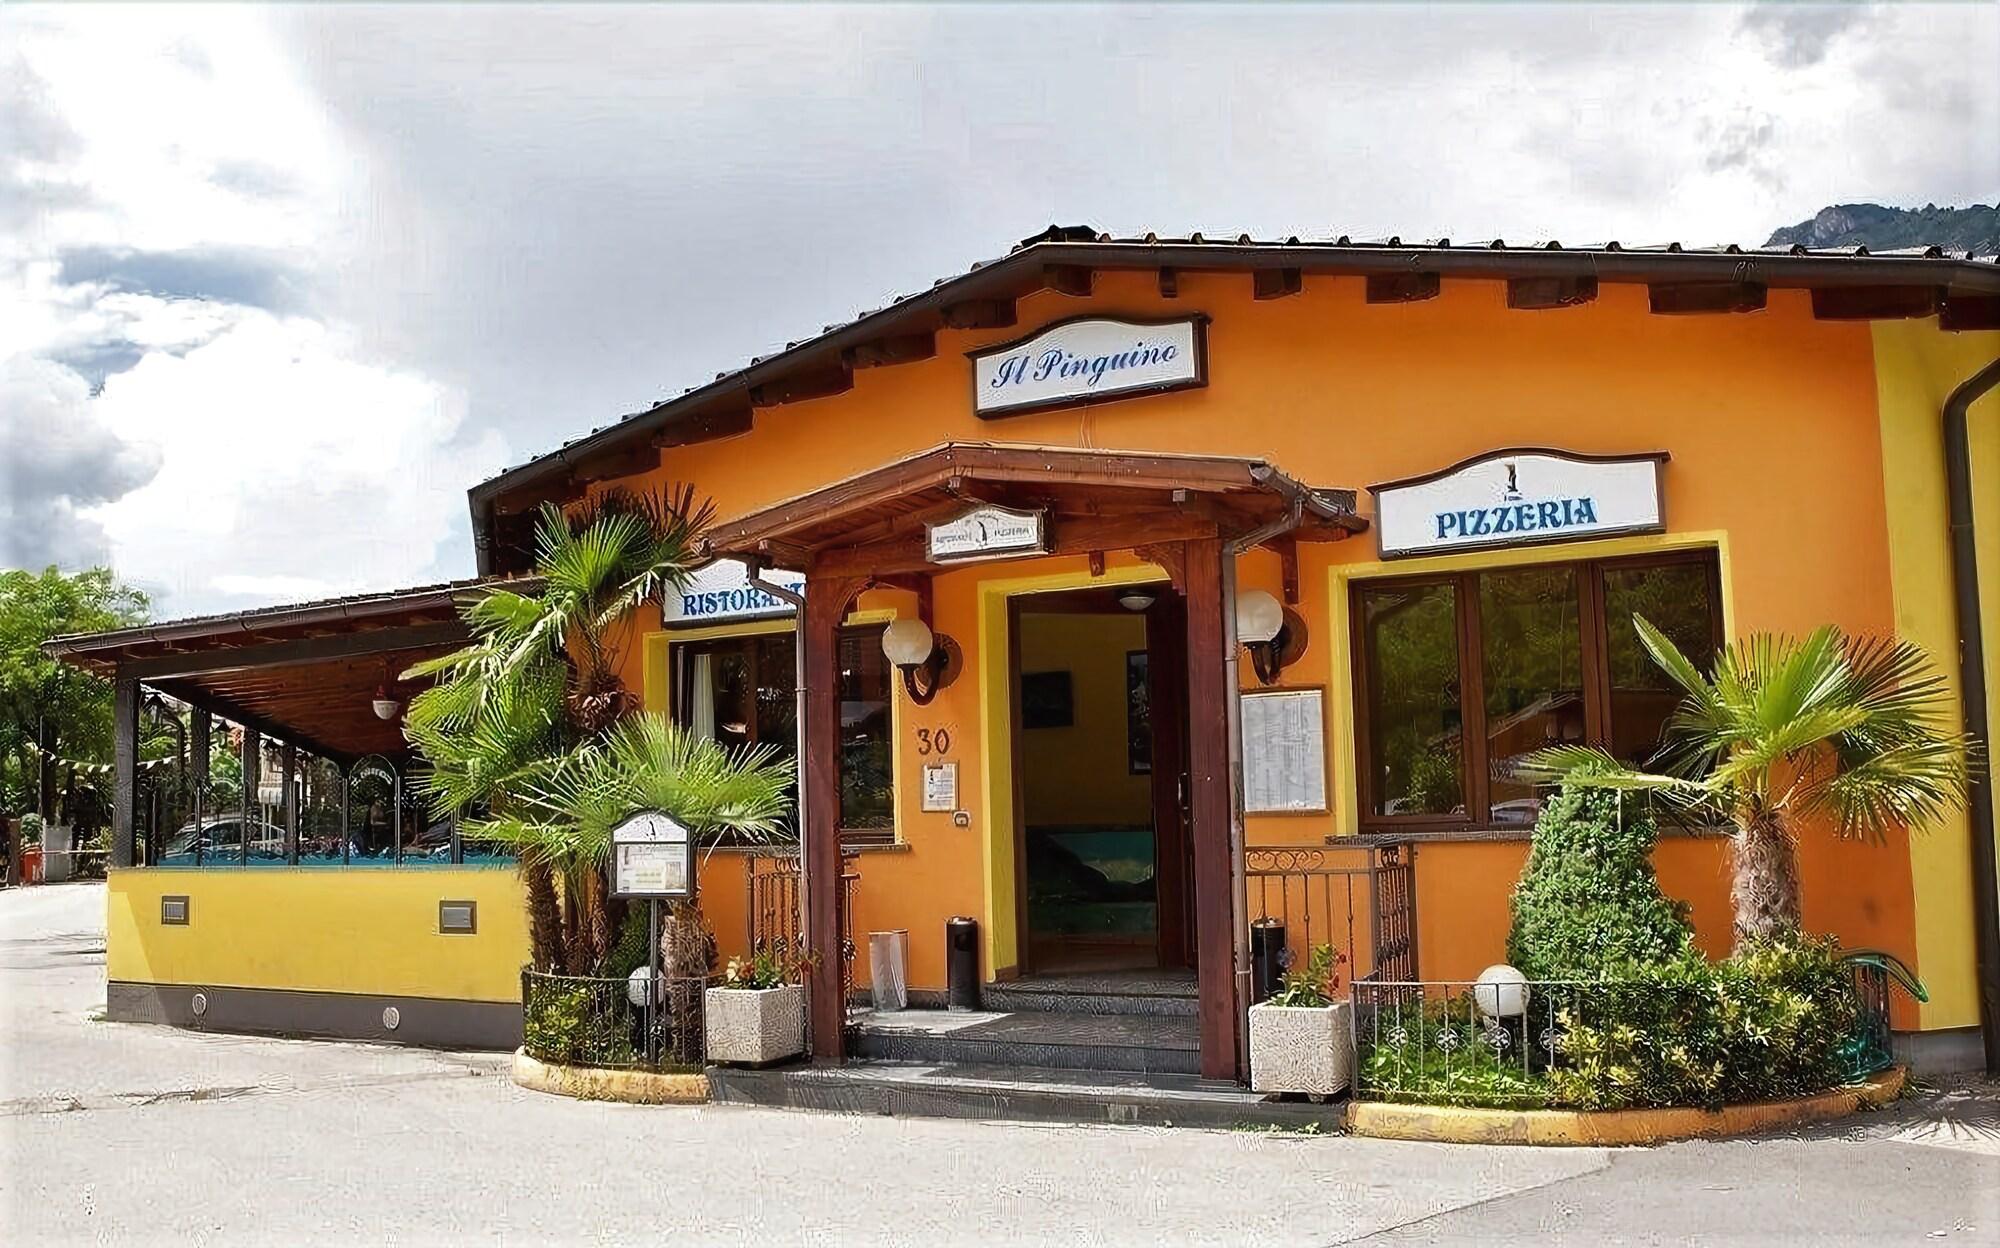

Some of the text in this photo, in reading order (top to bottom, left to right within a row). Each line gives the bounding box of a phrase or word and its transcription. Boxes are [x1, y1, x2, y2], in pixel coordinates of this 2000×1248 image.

[992, 341, 1178, 388] Il Pinguino
[1435, 497, 1597, 539] PIZZERIA
[918, 728, 949, 755] 30
